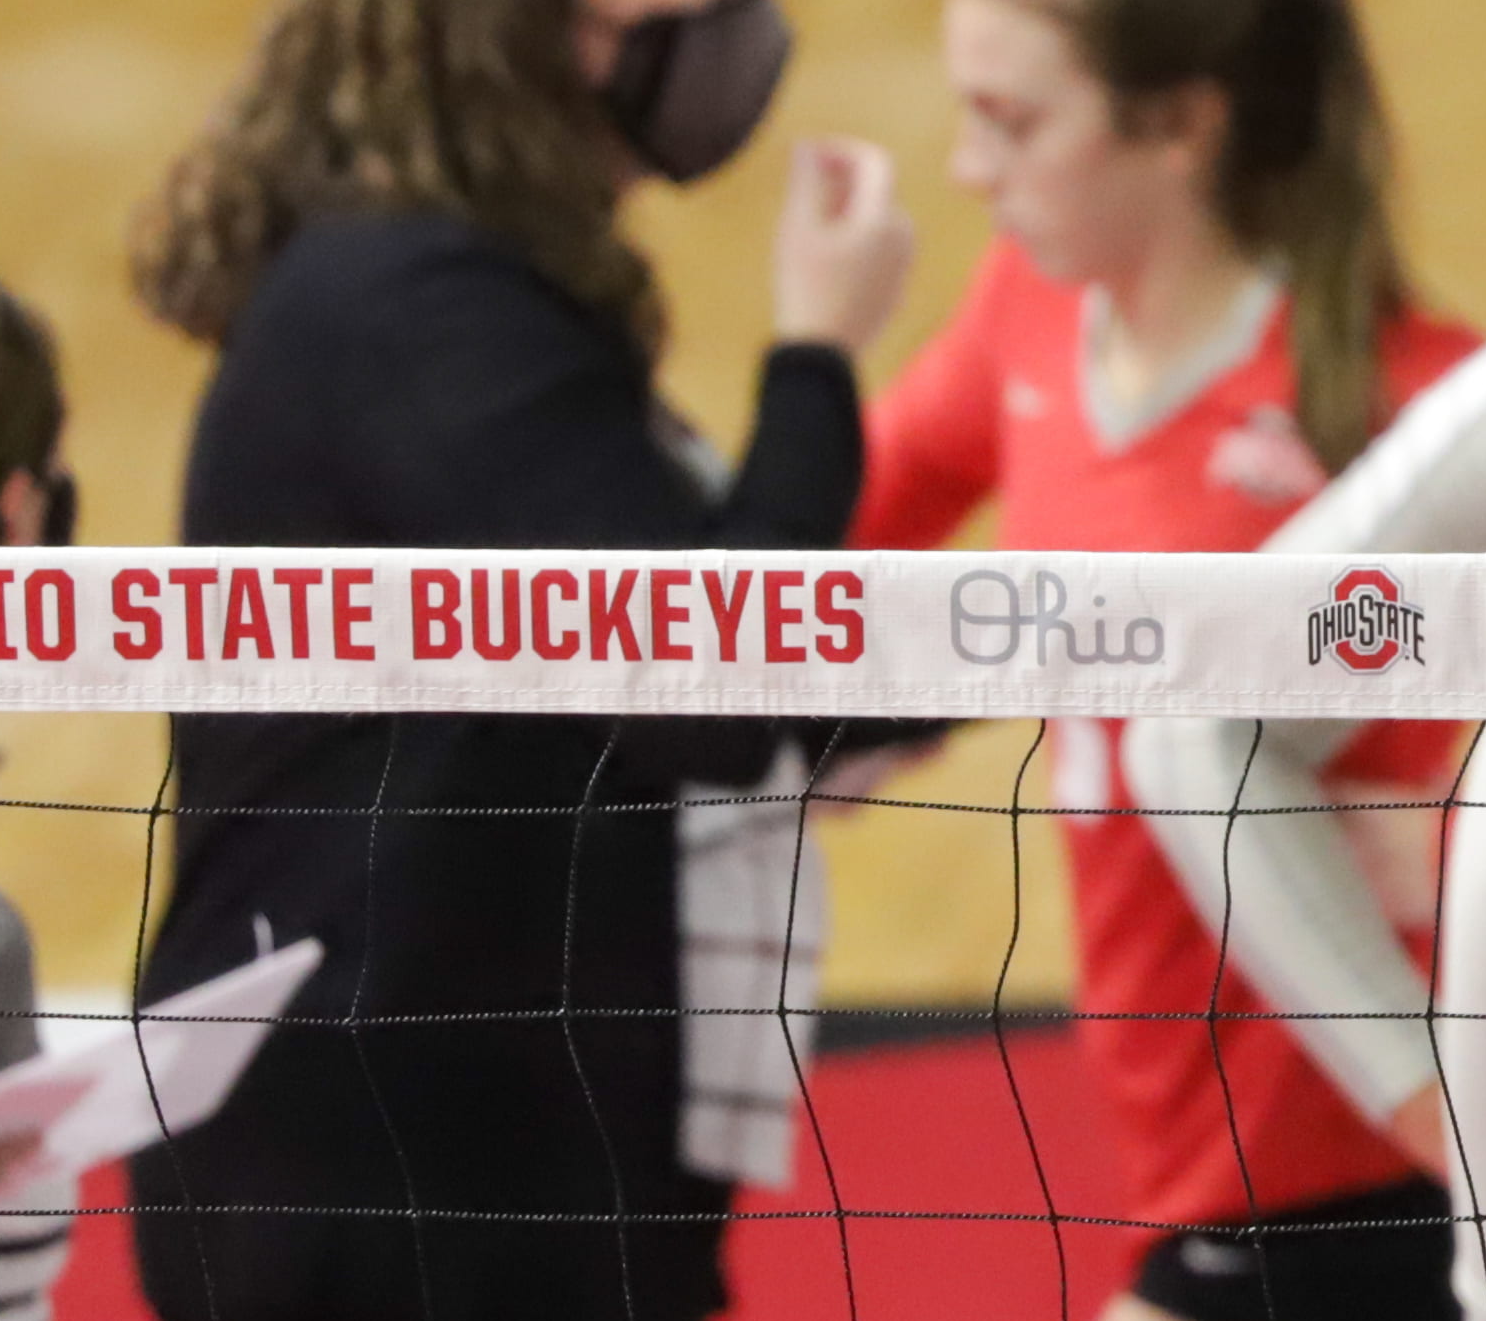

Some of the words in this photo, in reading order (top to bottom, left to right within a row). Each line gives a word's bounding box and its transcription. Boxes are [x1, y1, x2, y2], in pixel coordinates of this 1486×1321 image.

[112, 568, 374, 662] STATE
[411, 568, 864, 663] BUCKEYES
[950, 570, 1165, 667] Ohio
